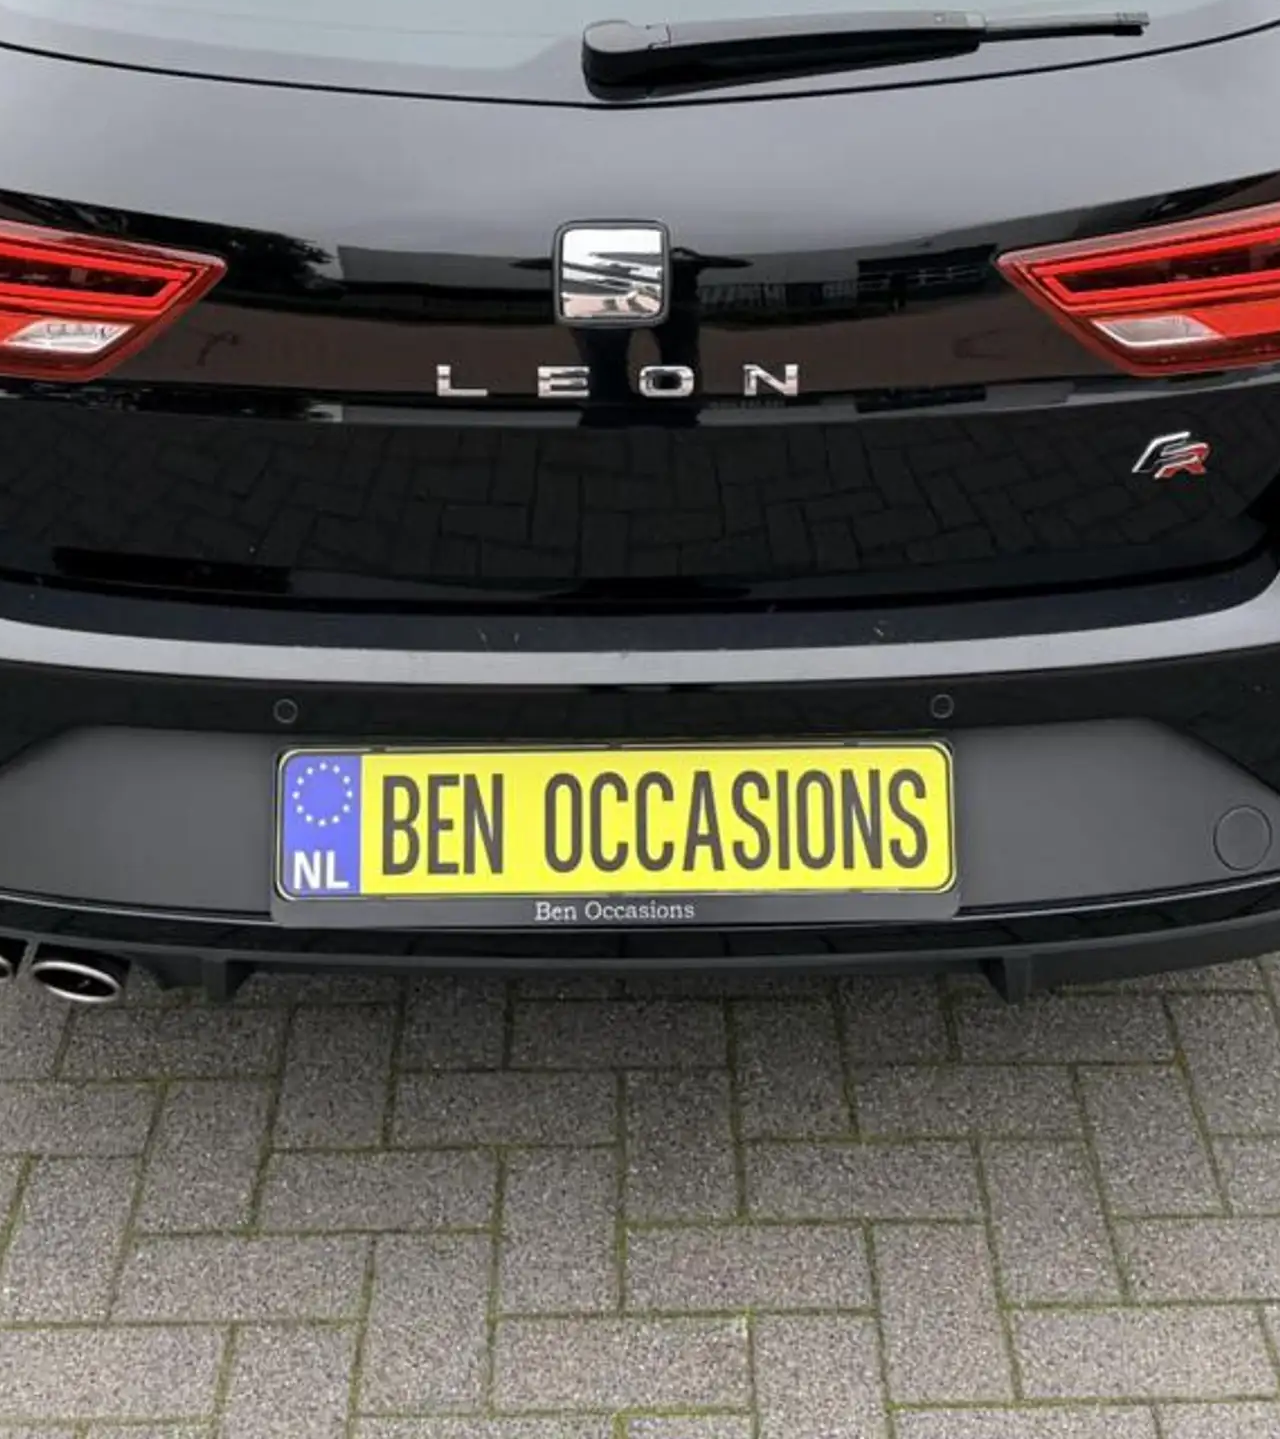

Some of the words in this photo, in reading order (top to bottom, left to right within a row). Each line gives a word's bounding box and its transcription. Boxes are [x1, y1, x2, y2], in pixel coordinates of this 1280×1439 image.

[436, 363, 800, 398] LEON
[381, 772, 504, 876] BEN
[543, 768, 928, 873] OCCASIONS
[293, 851, 349, 890] NL
[535, 901, 577, 921] Ben
[585, 901, 695, 920] Occasions
